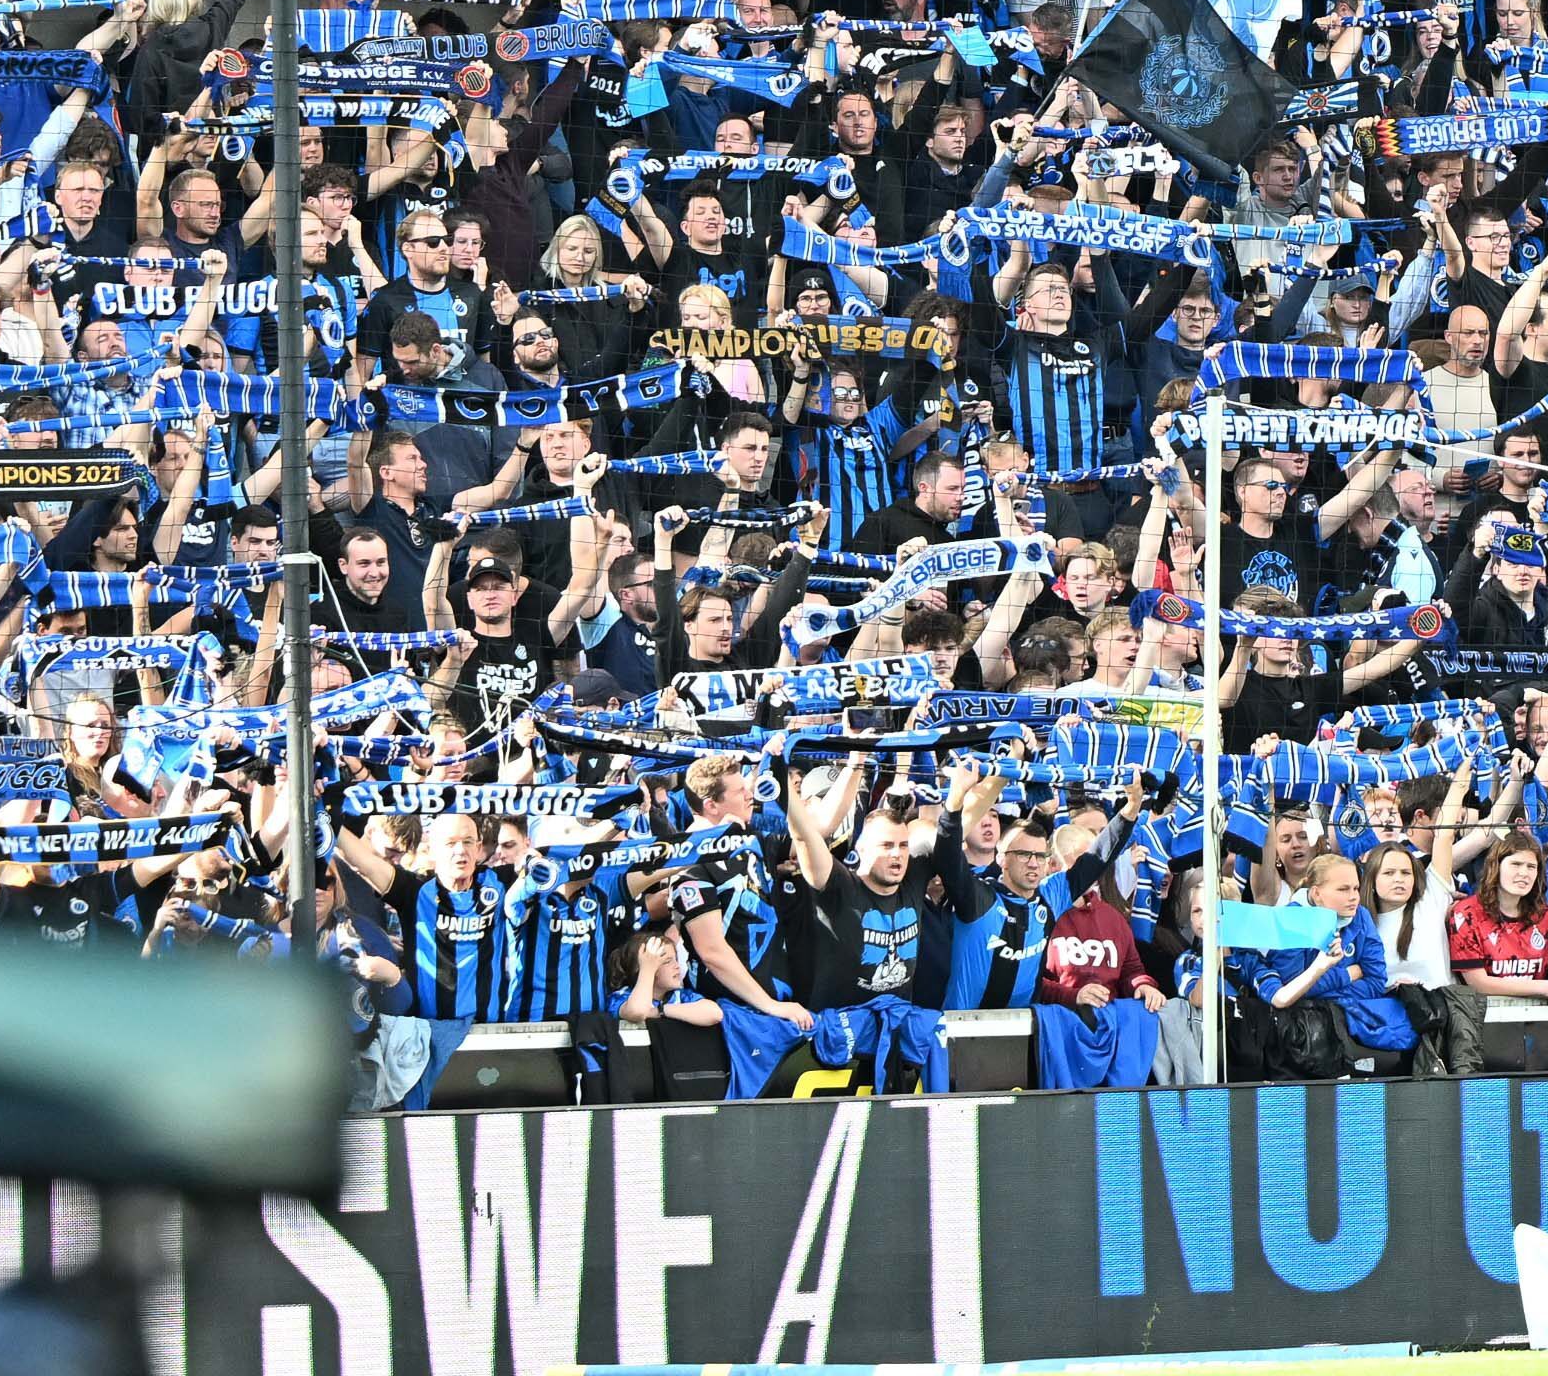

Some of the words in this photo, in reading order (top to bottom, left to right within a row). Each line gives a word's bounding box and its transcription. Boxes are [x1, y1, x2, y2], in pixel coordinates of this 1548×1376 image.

[95, 281, 176, 317] CLUB
[69, 462, 122, 485] 2021
[348, 783, 448, 816] CLUB
[454, 785, 616, 820] BRUGGE
[30, 826, 93, 852] NEVER
[99, 824, 155, 851] WALK
[161, 818, 226, 850] ALONE
[599, 842, 655, 871] HEART
[436, 914, 497, 935] UNIBET
[1051, 936, 1118, 967] 1891
[1491, 959, 1546, 977] UNIBET
